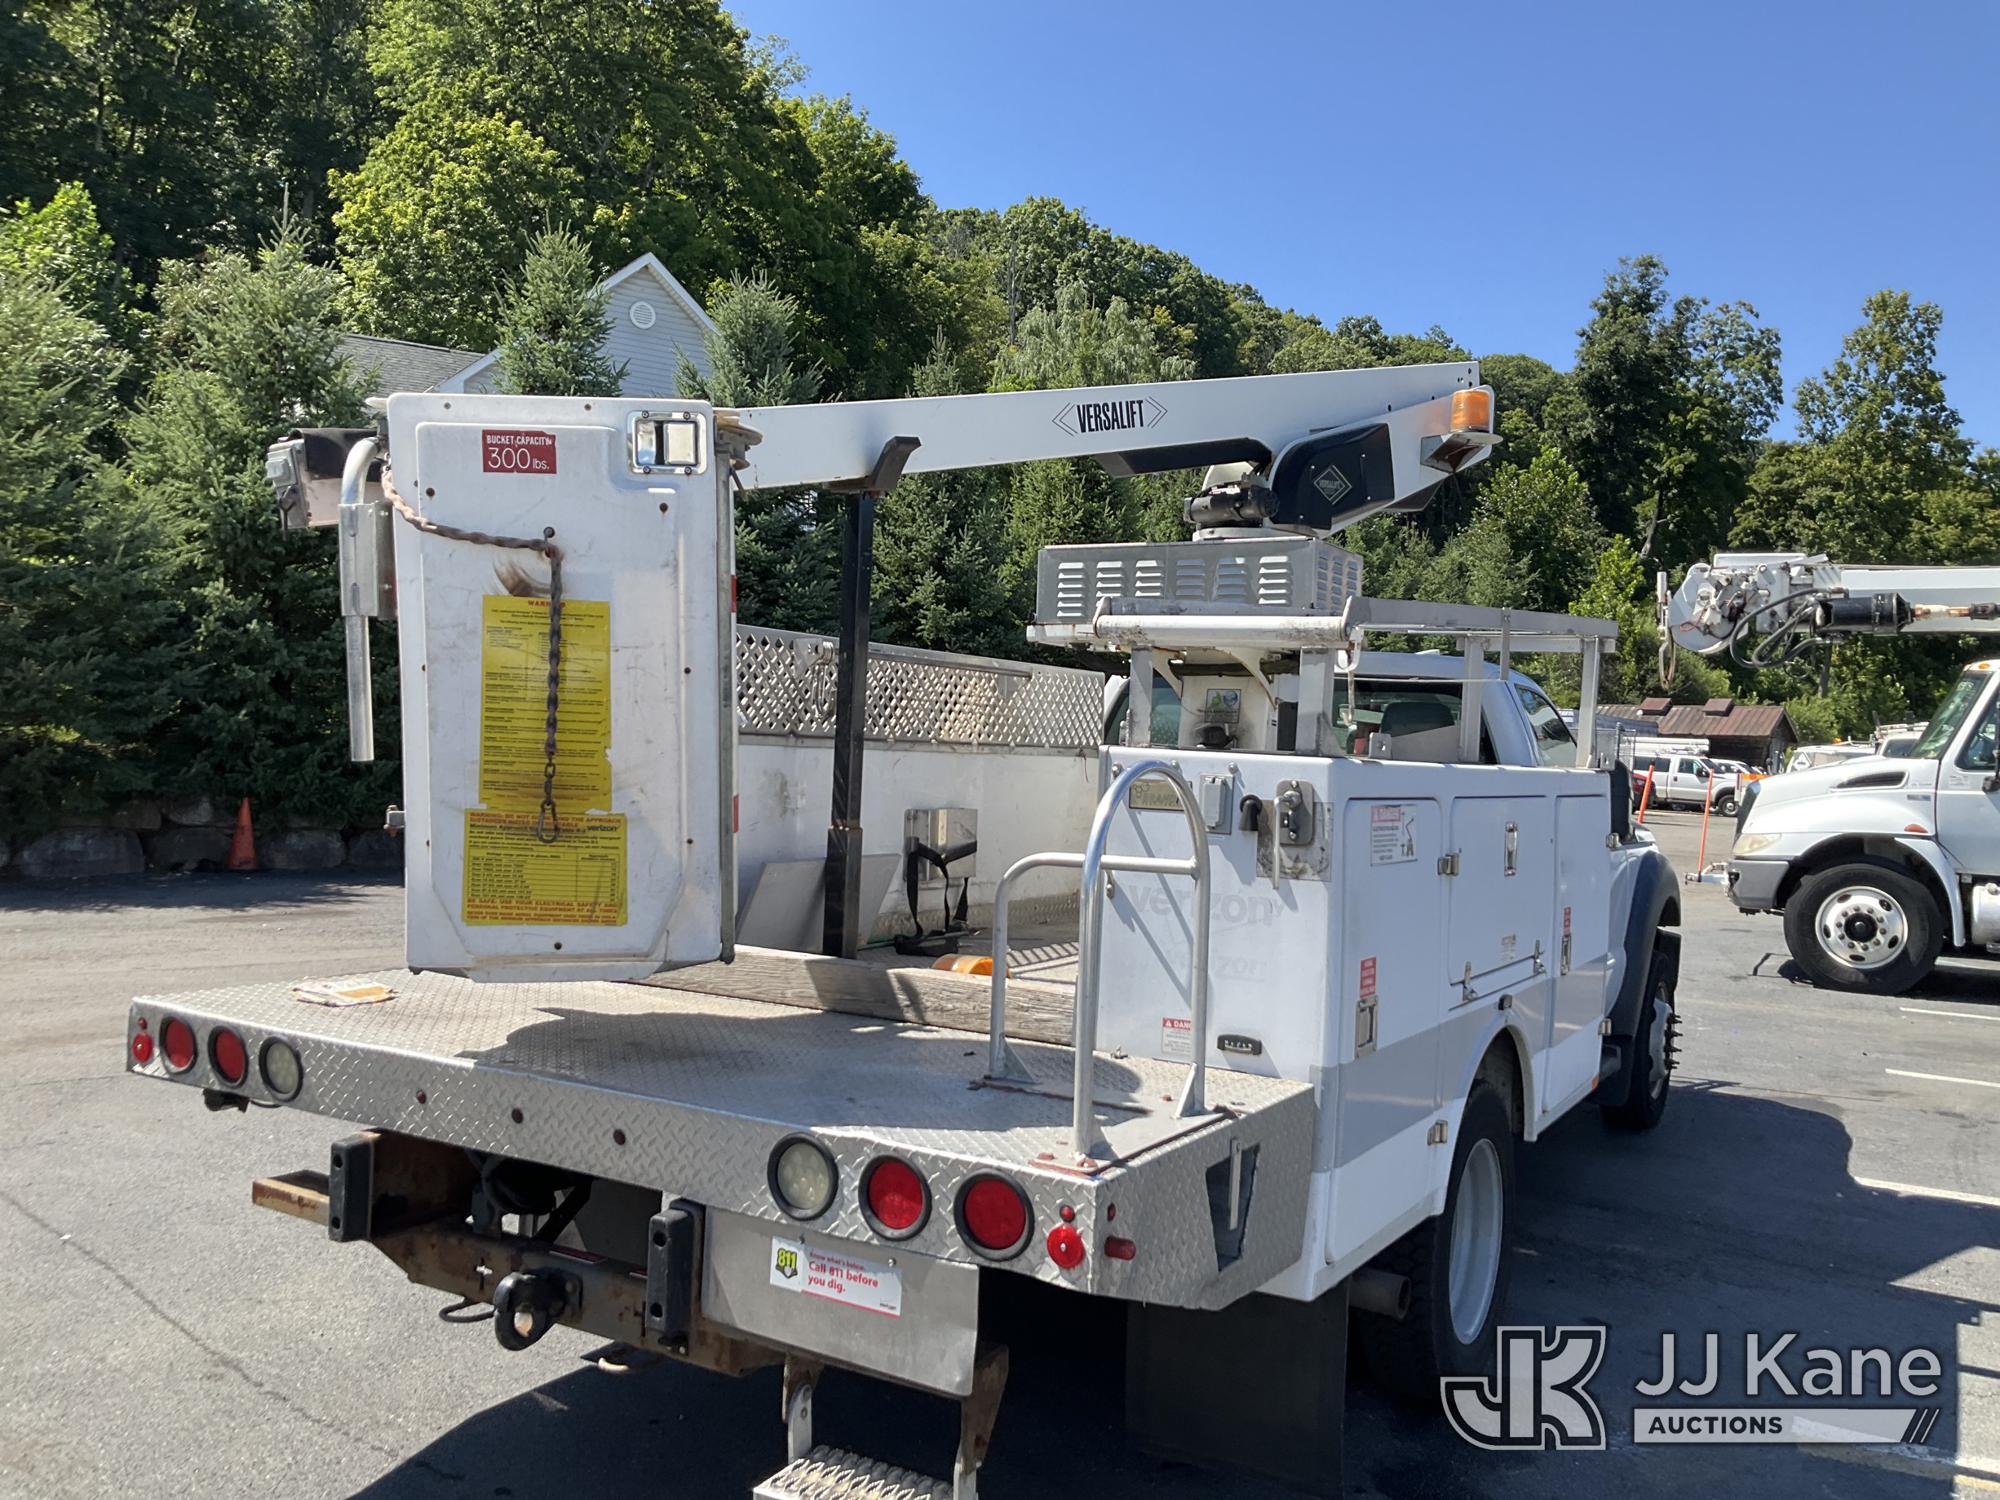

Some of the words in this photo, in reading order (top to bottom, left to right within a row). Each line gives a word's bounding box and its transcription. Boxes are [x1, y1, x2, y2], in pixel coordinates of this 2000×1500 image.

[1077, 400, 1144, 433] VERSALIFT
[486, 435, 515, 445] BUCKET
[488, 447, 531, 469] 300
[532, 458, 550, 470] lbs.
[1128, 884, 1272, 926] verzon
[777, 1247, 798, 1271] 811
[808, 1260, 827, 1274] Call
[829, 1265, 844, 1279] 811
[846, 1268, 879, 1288] before
[808, 1273, 826, 1287] you
[828, 1279, 846, 1294] dig.
